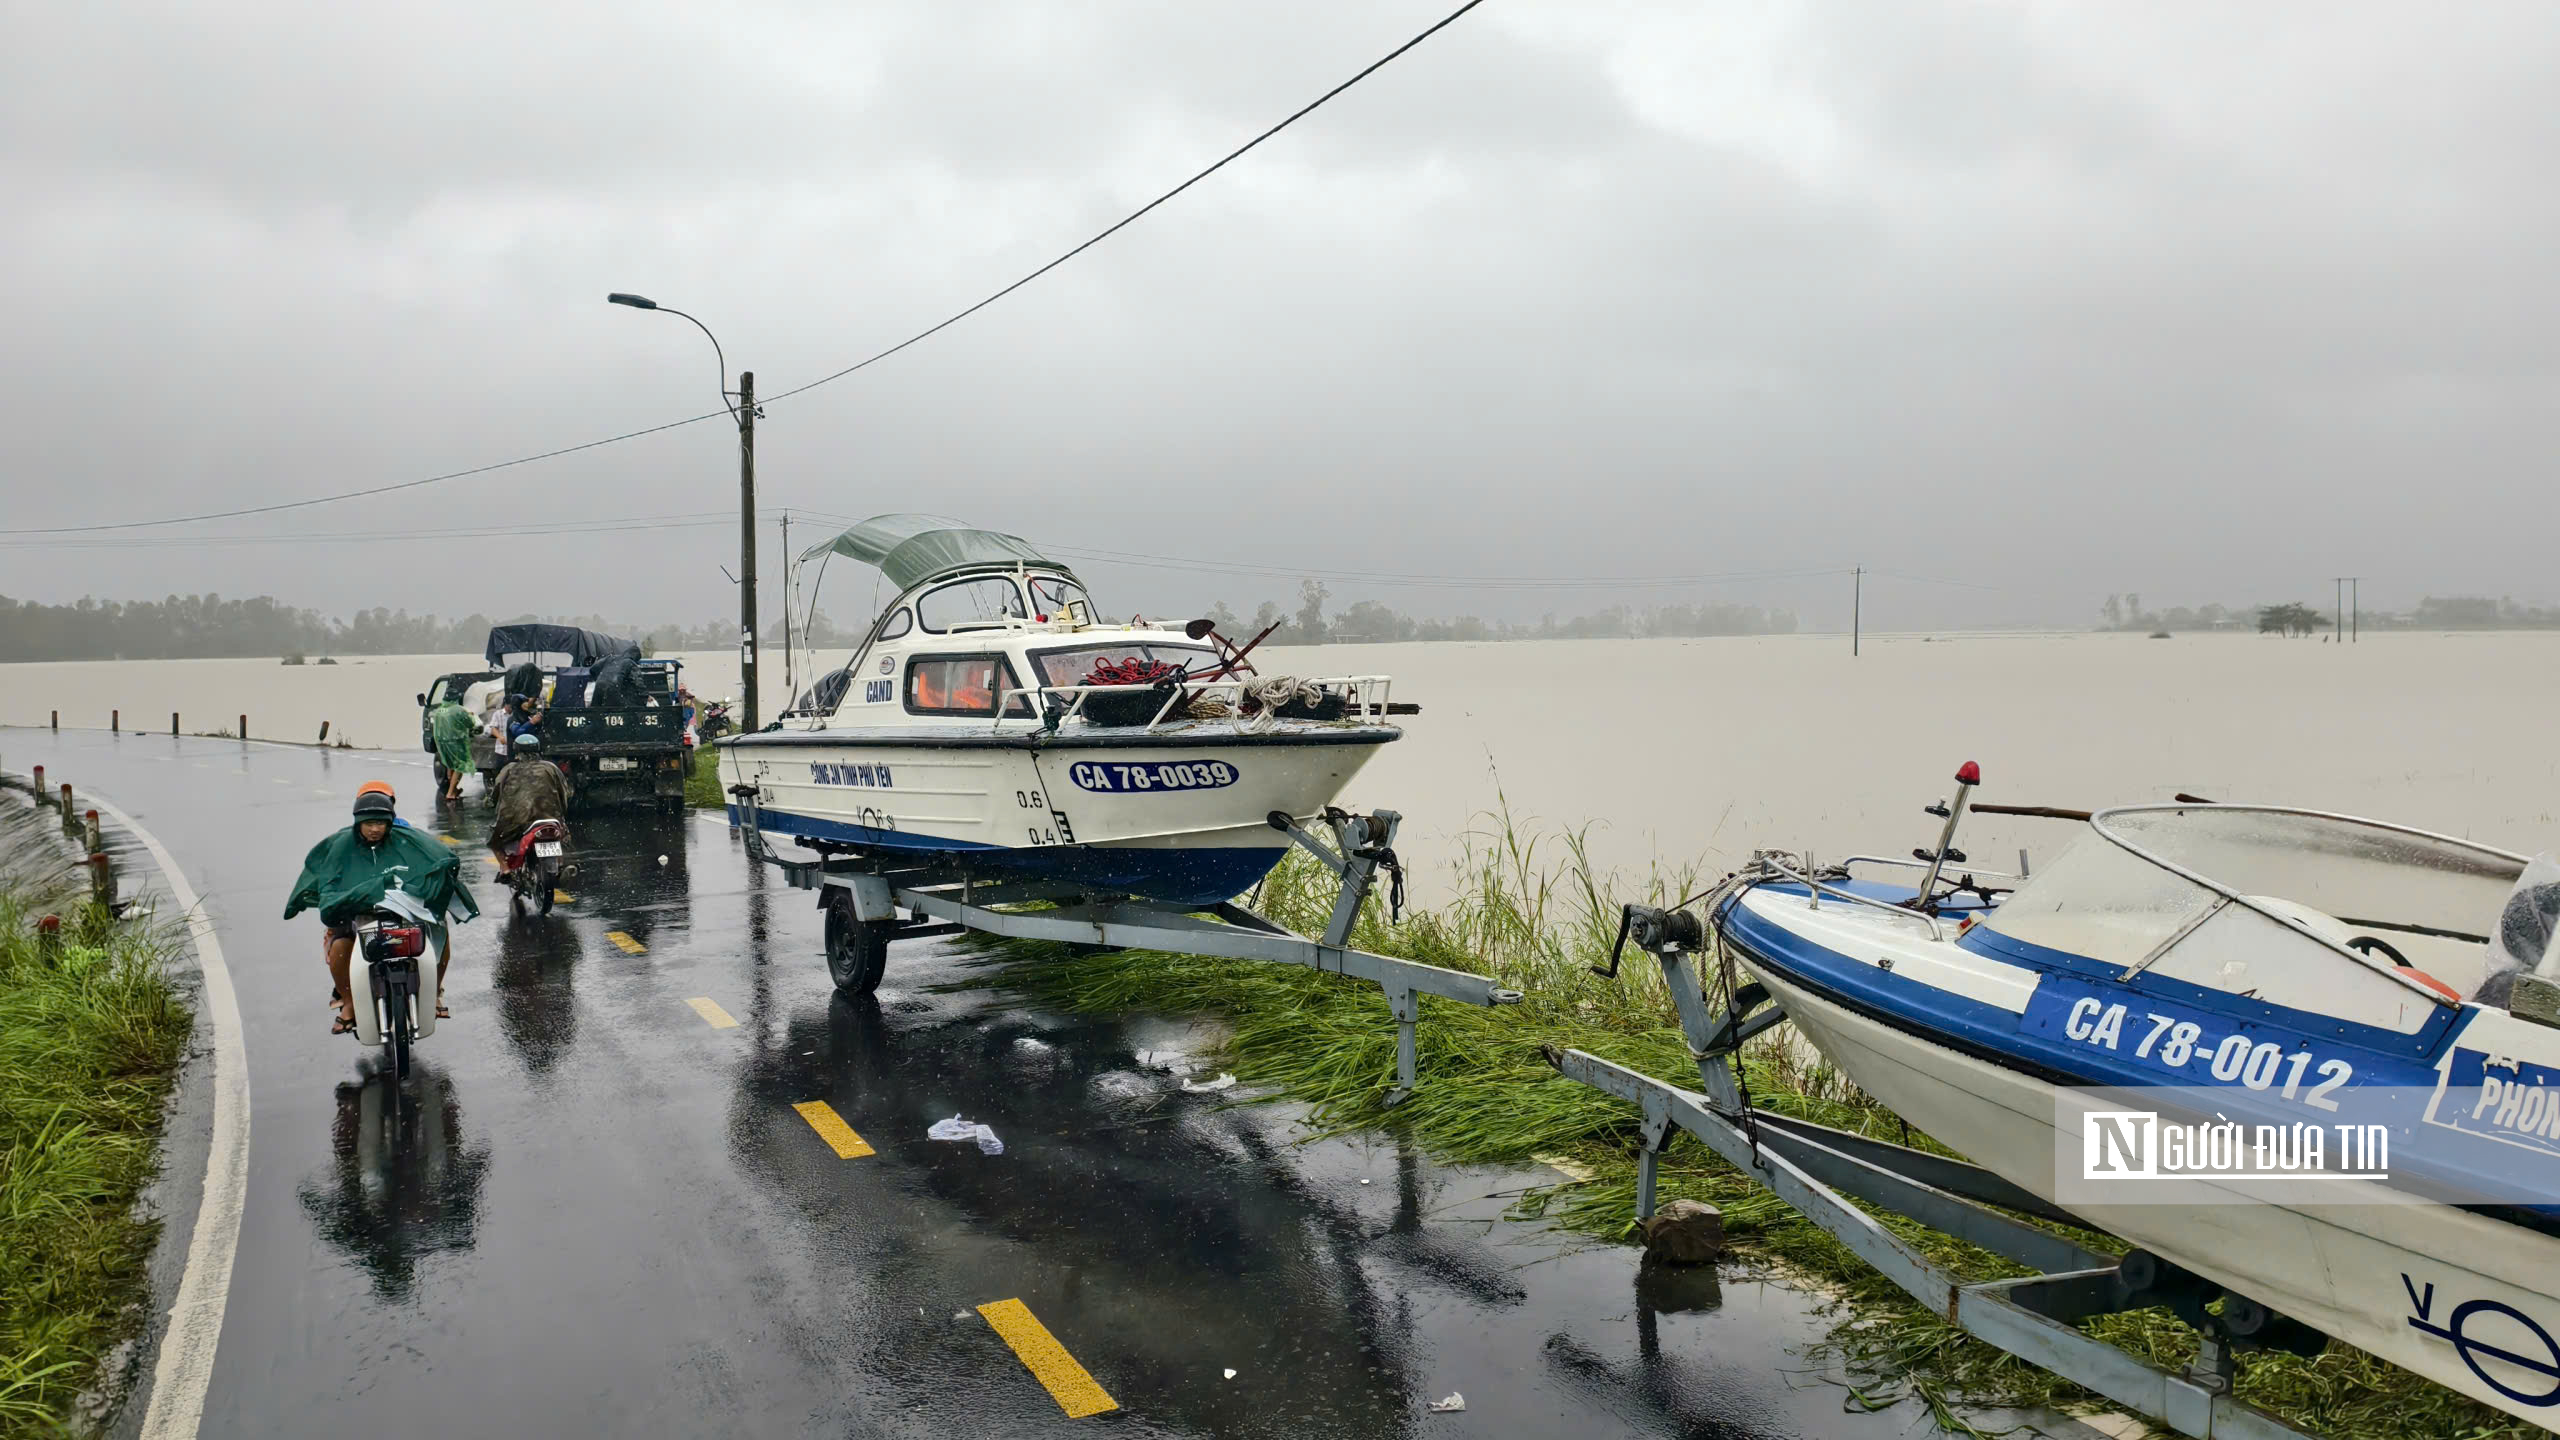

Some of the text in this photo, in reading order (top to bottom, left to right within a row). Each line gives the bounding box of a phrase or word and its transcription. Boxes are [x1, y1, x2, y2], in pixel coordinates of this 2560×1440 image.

[866, 680, 893, 703] CAND
[604, 715, 624, 726] 104
[644, 715, 658, 726] 35
[858, 761, 875, 787] PHÚ
[874, 762, 893, 788] YÊN
[1075, 762, 1232, 790] CA 78-0039
[1017, 790, 1043, 809] 0.6
[1028, 827, 1056, 846] 0.4
[2065, 997, 2353, 1113] CA 78-0012
